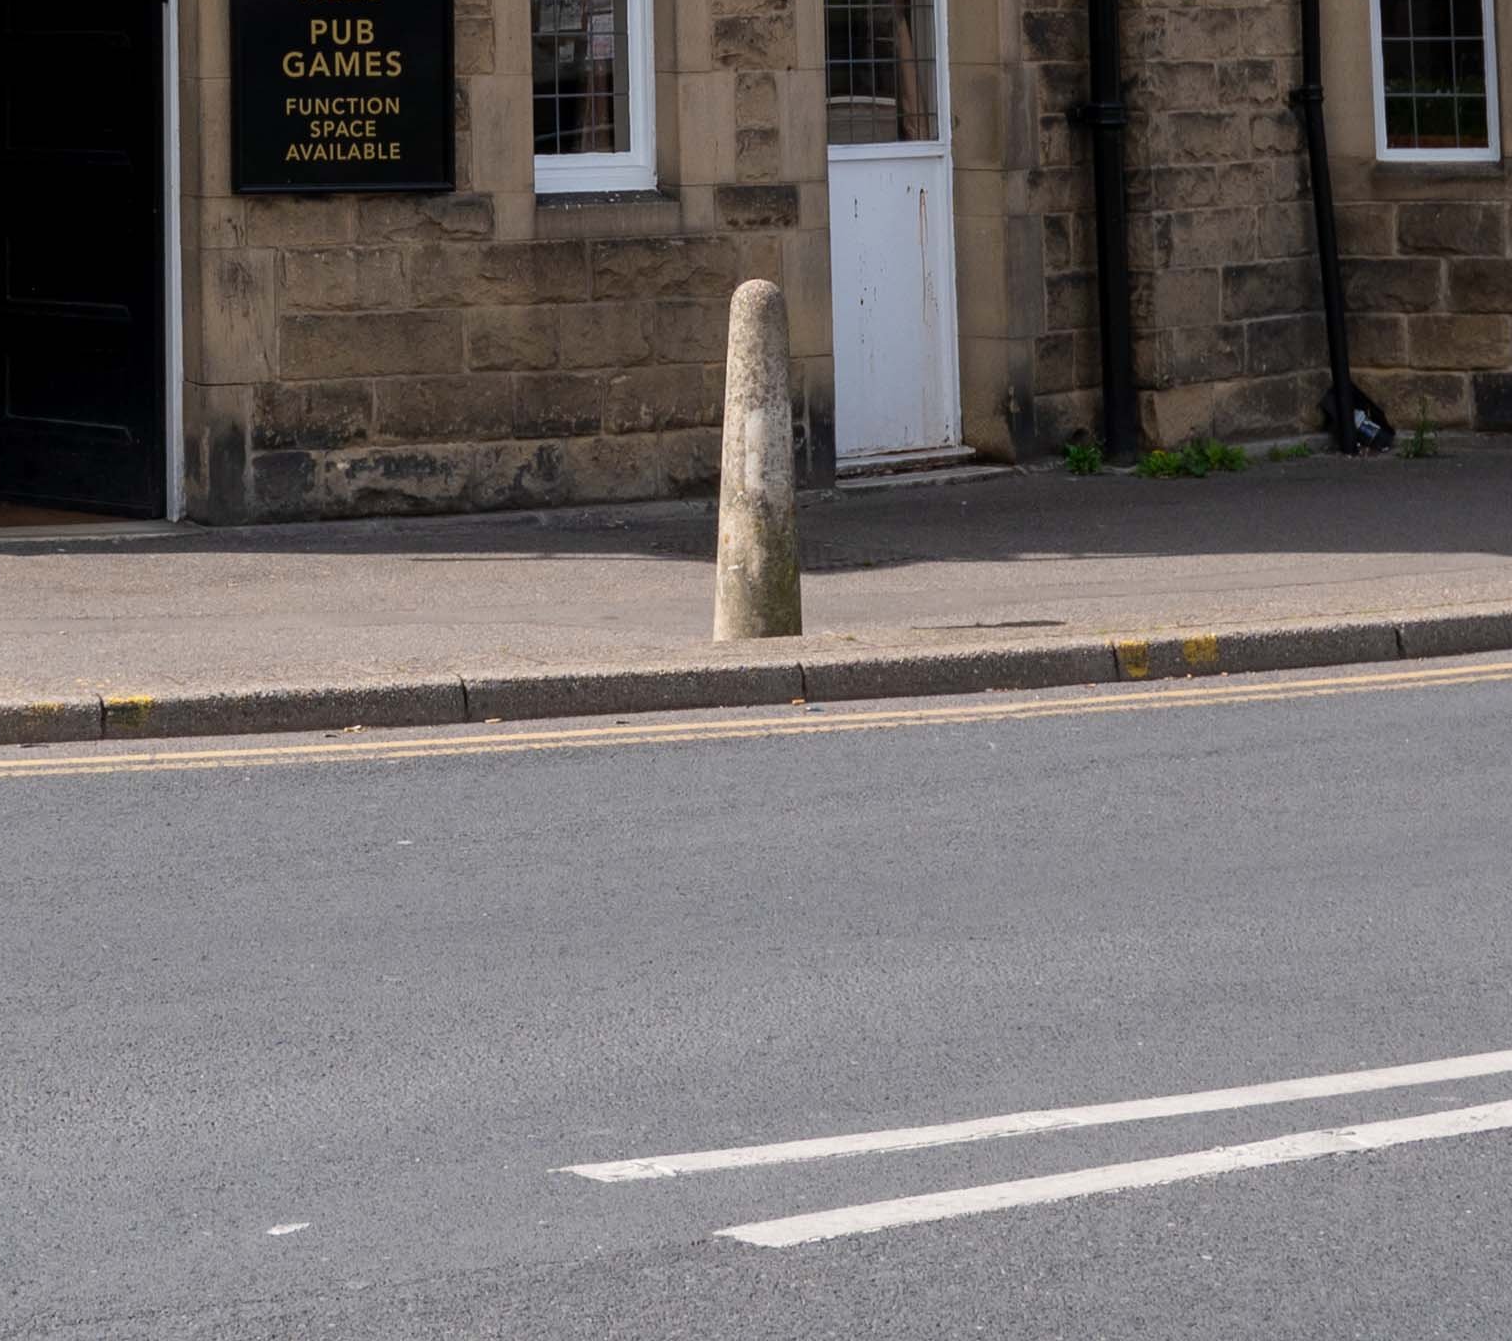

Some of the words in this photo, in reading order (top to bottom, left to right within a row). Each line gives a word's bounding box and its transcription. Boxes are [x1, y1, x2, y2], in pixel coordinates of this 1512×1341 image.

[310, 19, 375, 45] PUB
[282, 51, 402, 78] GAMES
[285, 97, 400, 116] FUNCTION
[310, 120, 376, 138] SPACE
[285, 142, 401, 161] AVAILABLE
